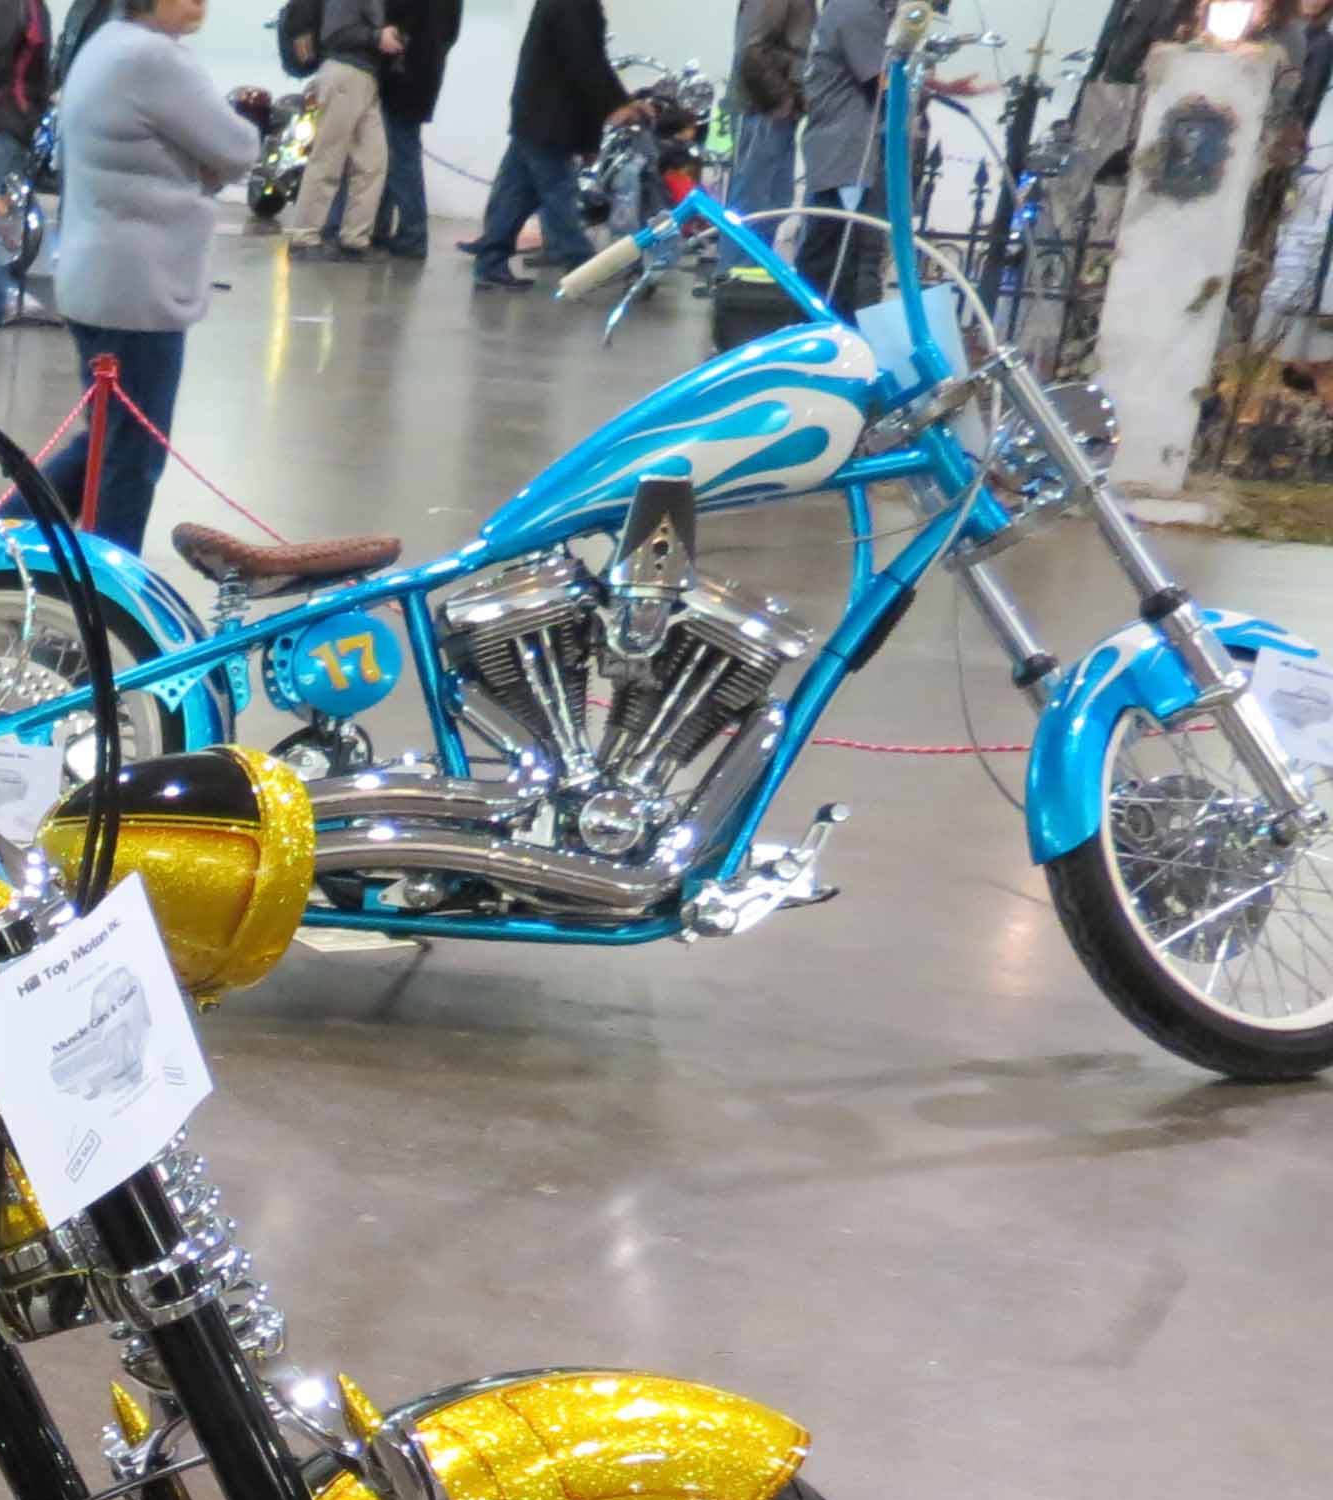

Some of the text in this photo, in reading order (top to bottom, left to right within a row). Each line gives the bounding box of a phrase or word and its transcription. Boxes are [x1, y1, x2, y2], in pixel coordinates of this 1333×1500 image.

[308, 630, 381, 690] 17
[16, 974, 42, 997] Hill
[42, 959, 70, 980] Top
